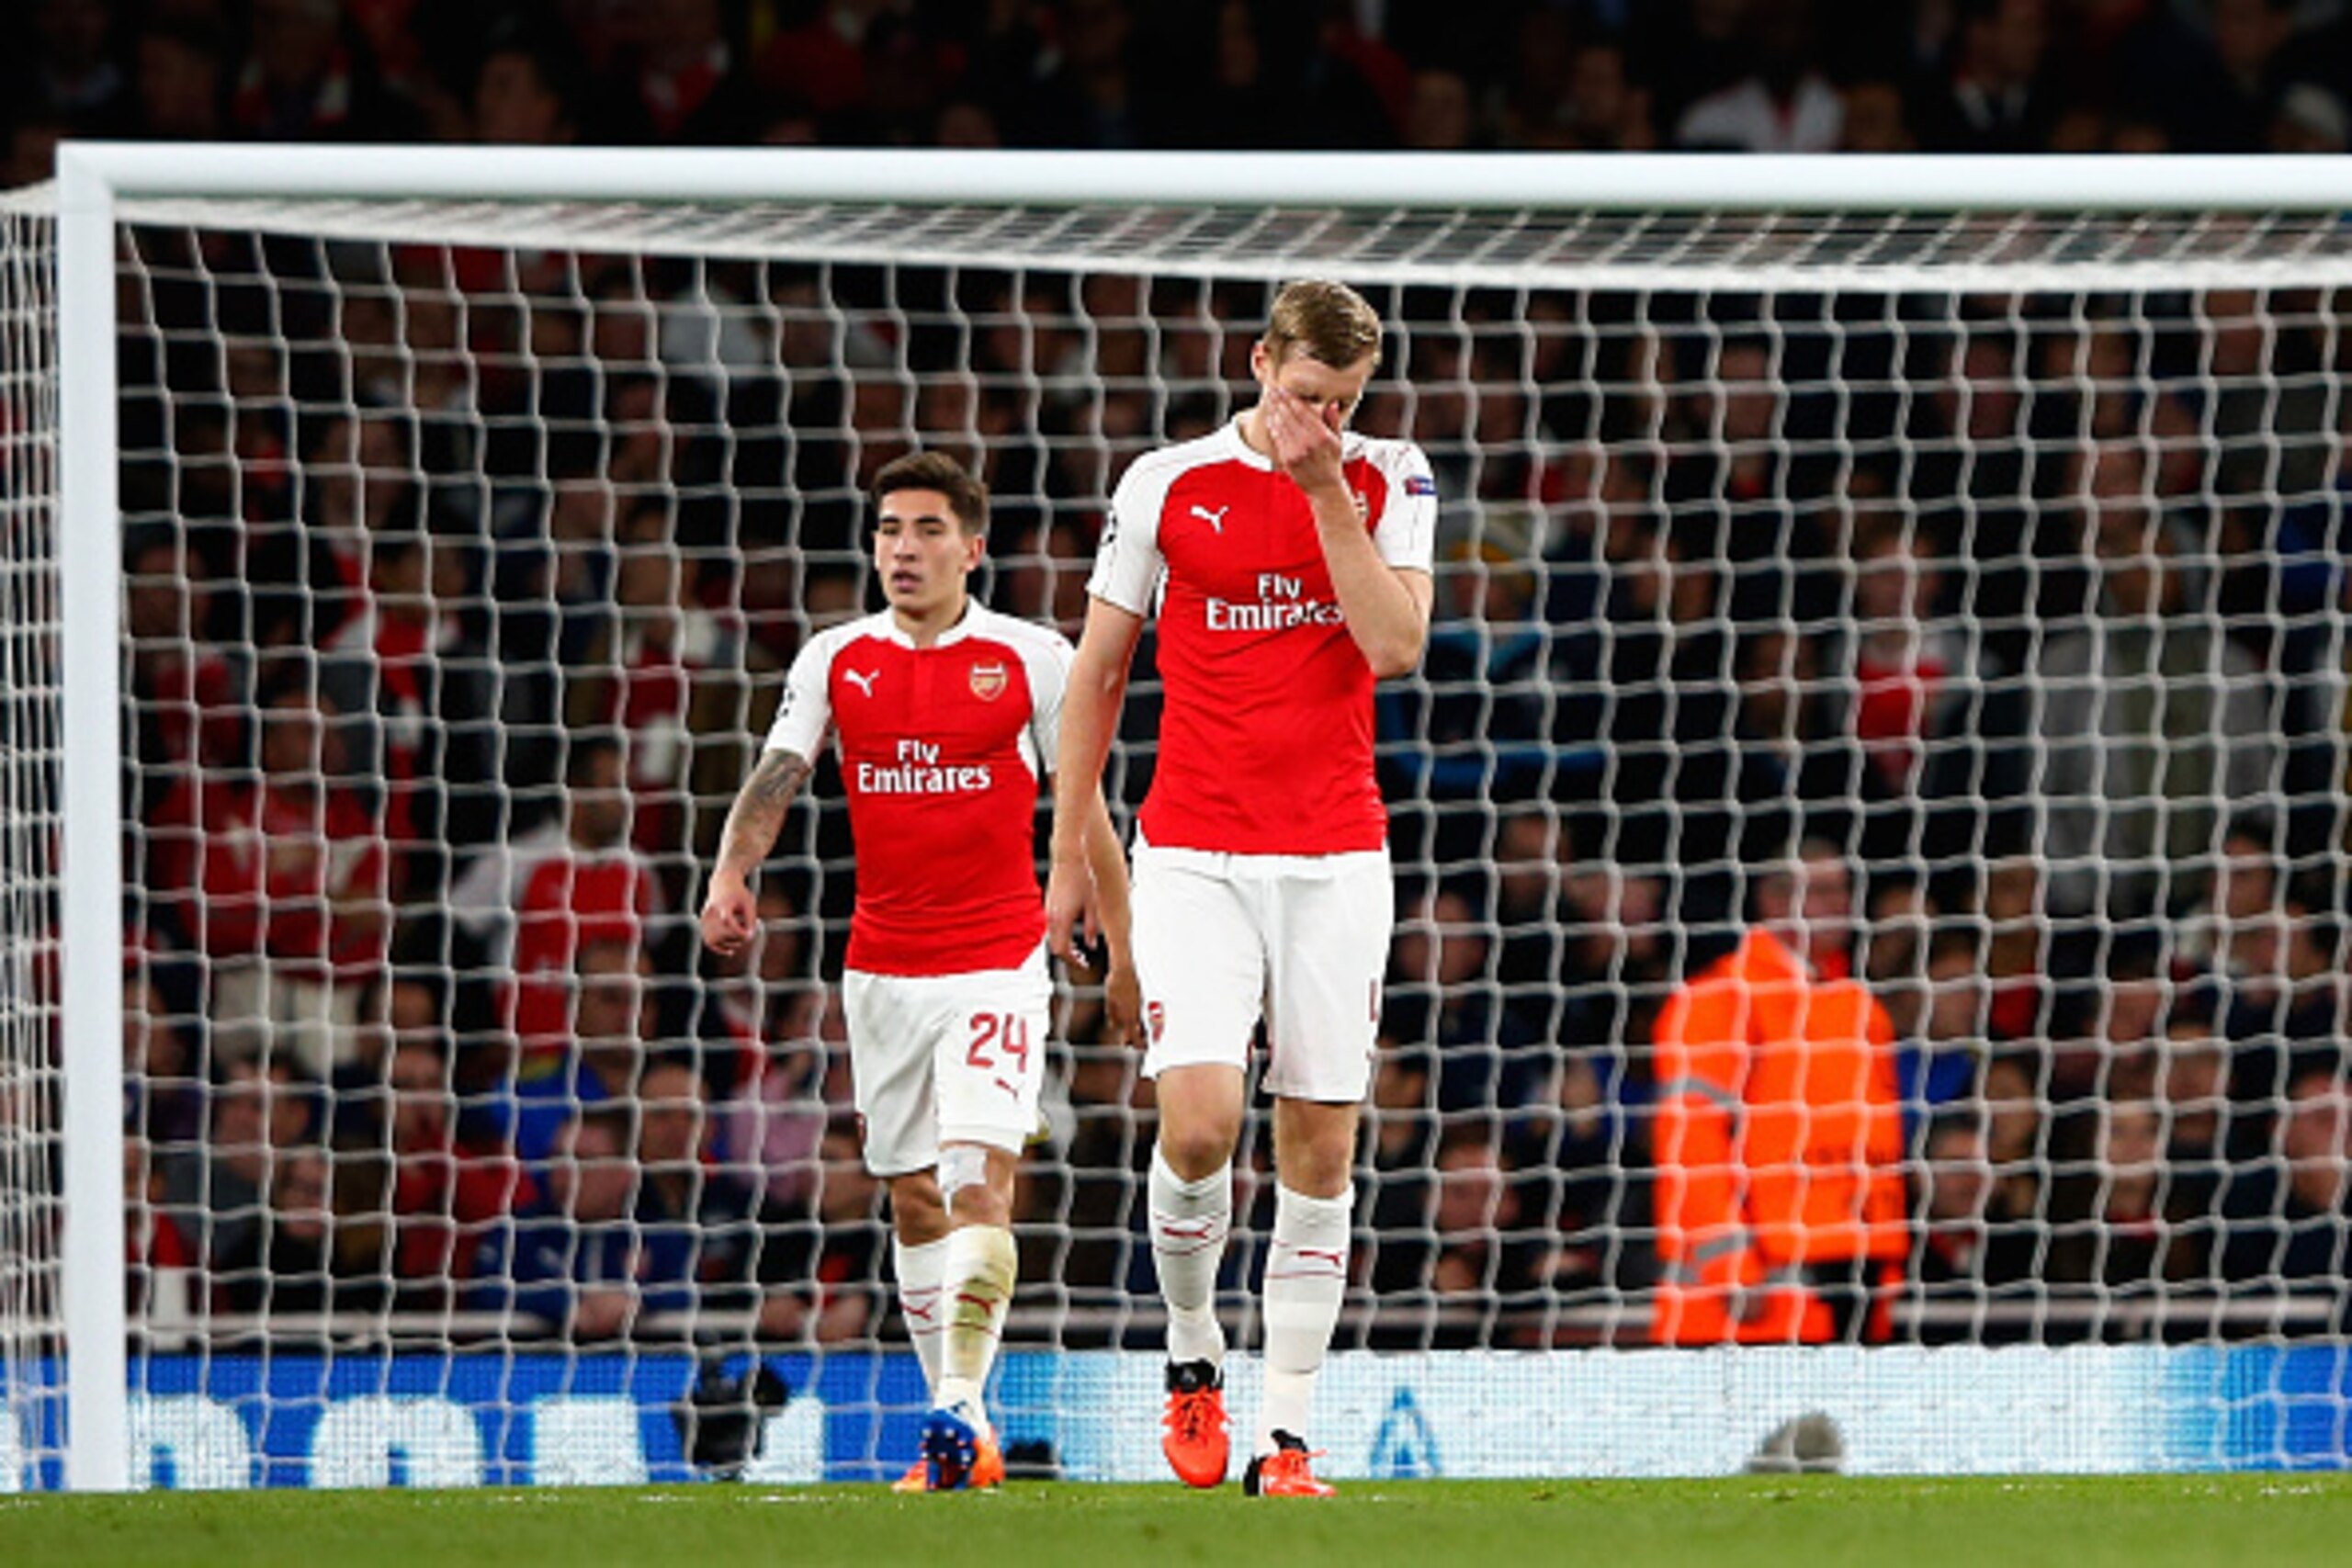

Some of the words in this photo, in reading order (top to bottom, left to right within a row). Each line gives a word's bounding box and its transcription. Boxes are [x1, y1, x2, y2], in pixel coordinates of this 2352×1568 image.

[1258, 573, 1301, 598] Fly
[898, 739, 940, 764] Fly
[858, 762, 991, 793] Emirates
[967, 1012, 1027, 1073] 24
